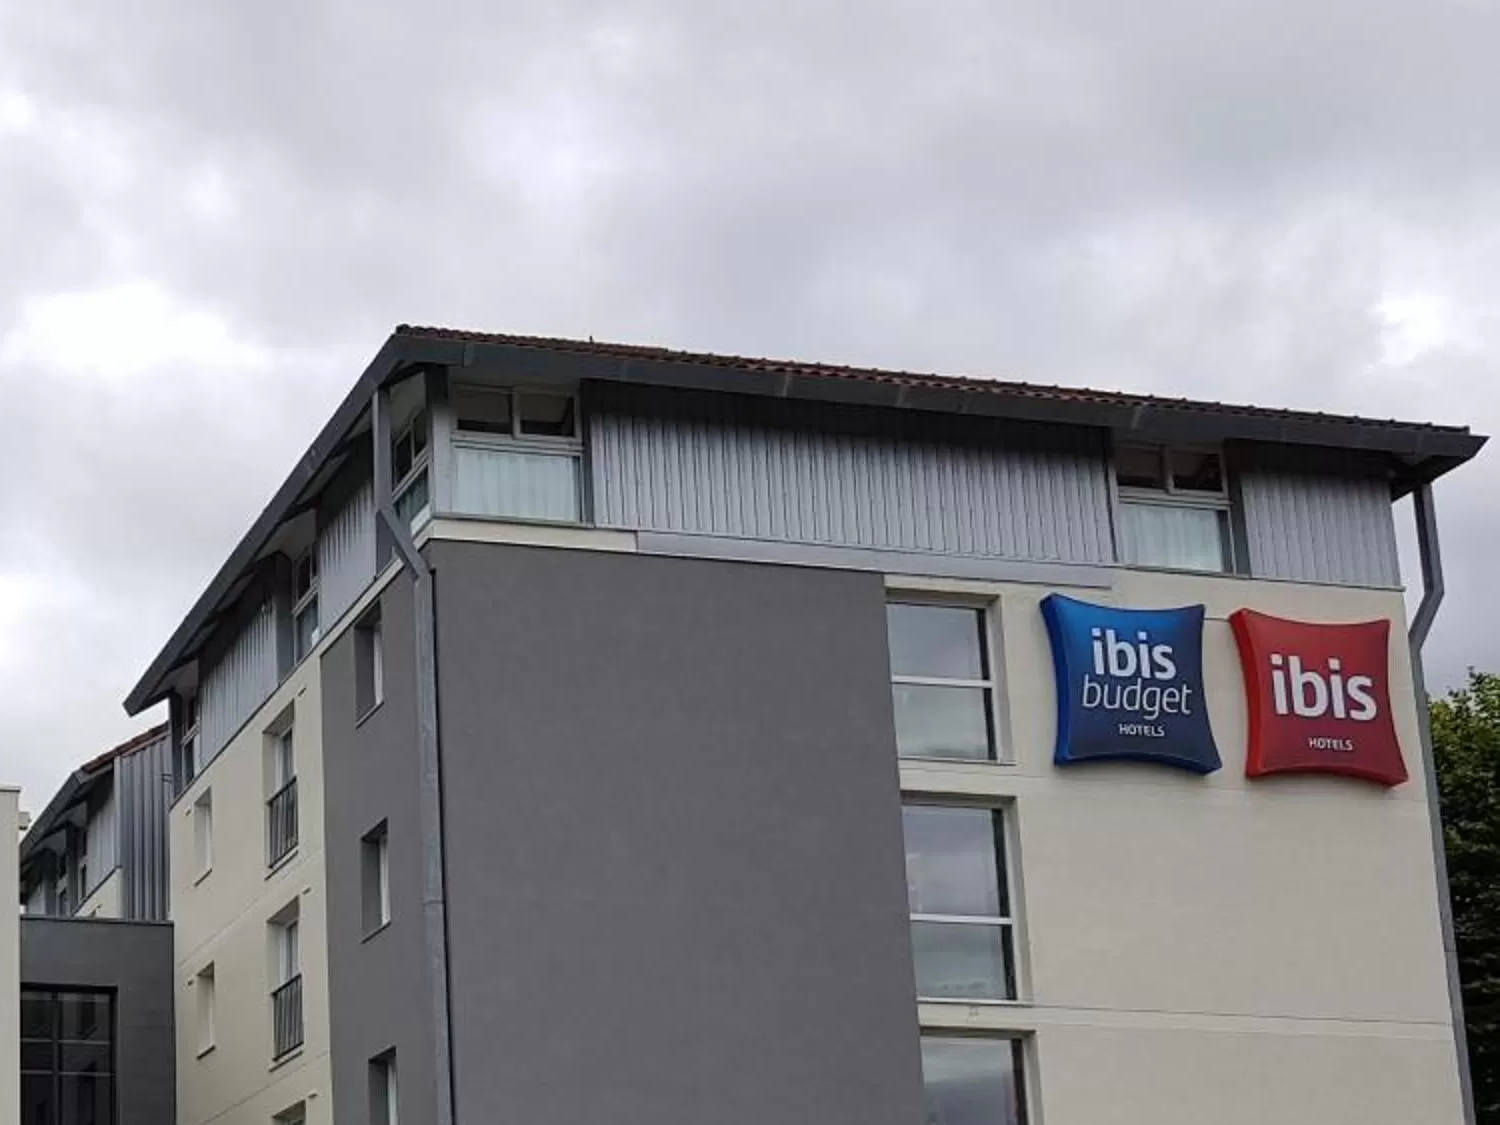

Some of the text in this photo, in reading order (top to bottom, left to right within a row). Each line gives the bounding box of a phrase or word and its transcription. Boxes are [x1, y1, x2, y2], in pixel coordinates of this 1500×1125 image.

[1092, 627, 1177, 680] ibis
[1081, 674, 1193, 720] budget
[1270, 653, 1378, 721] ibis
[1118, 722, 1166, 737] HOTELS
[1308, 736, 1355, 752] HOTELS
